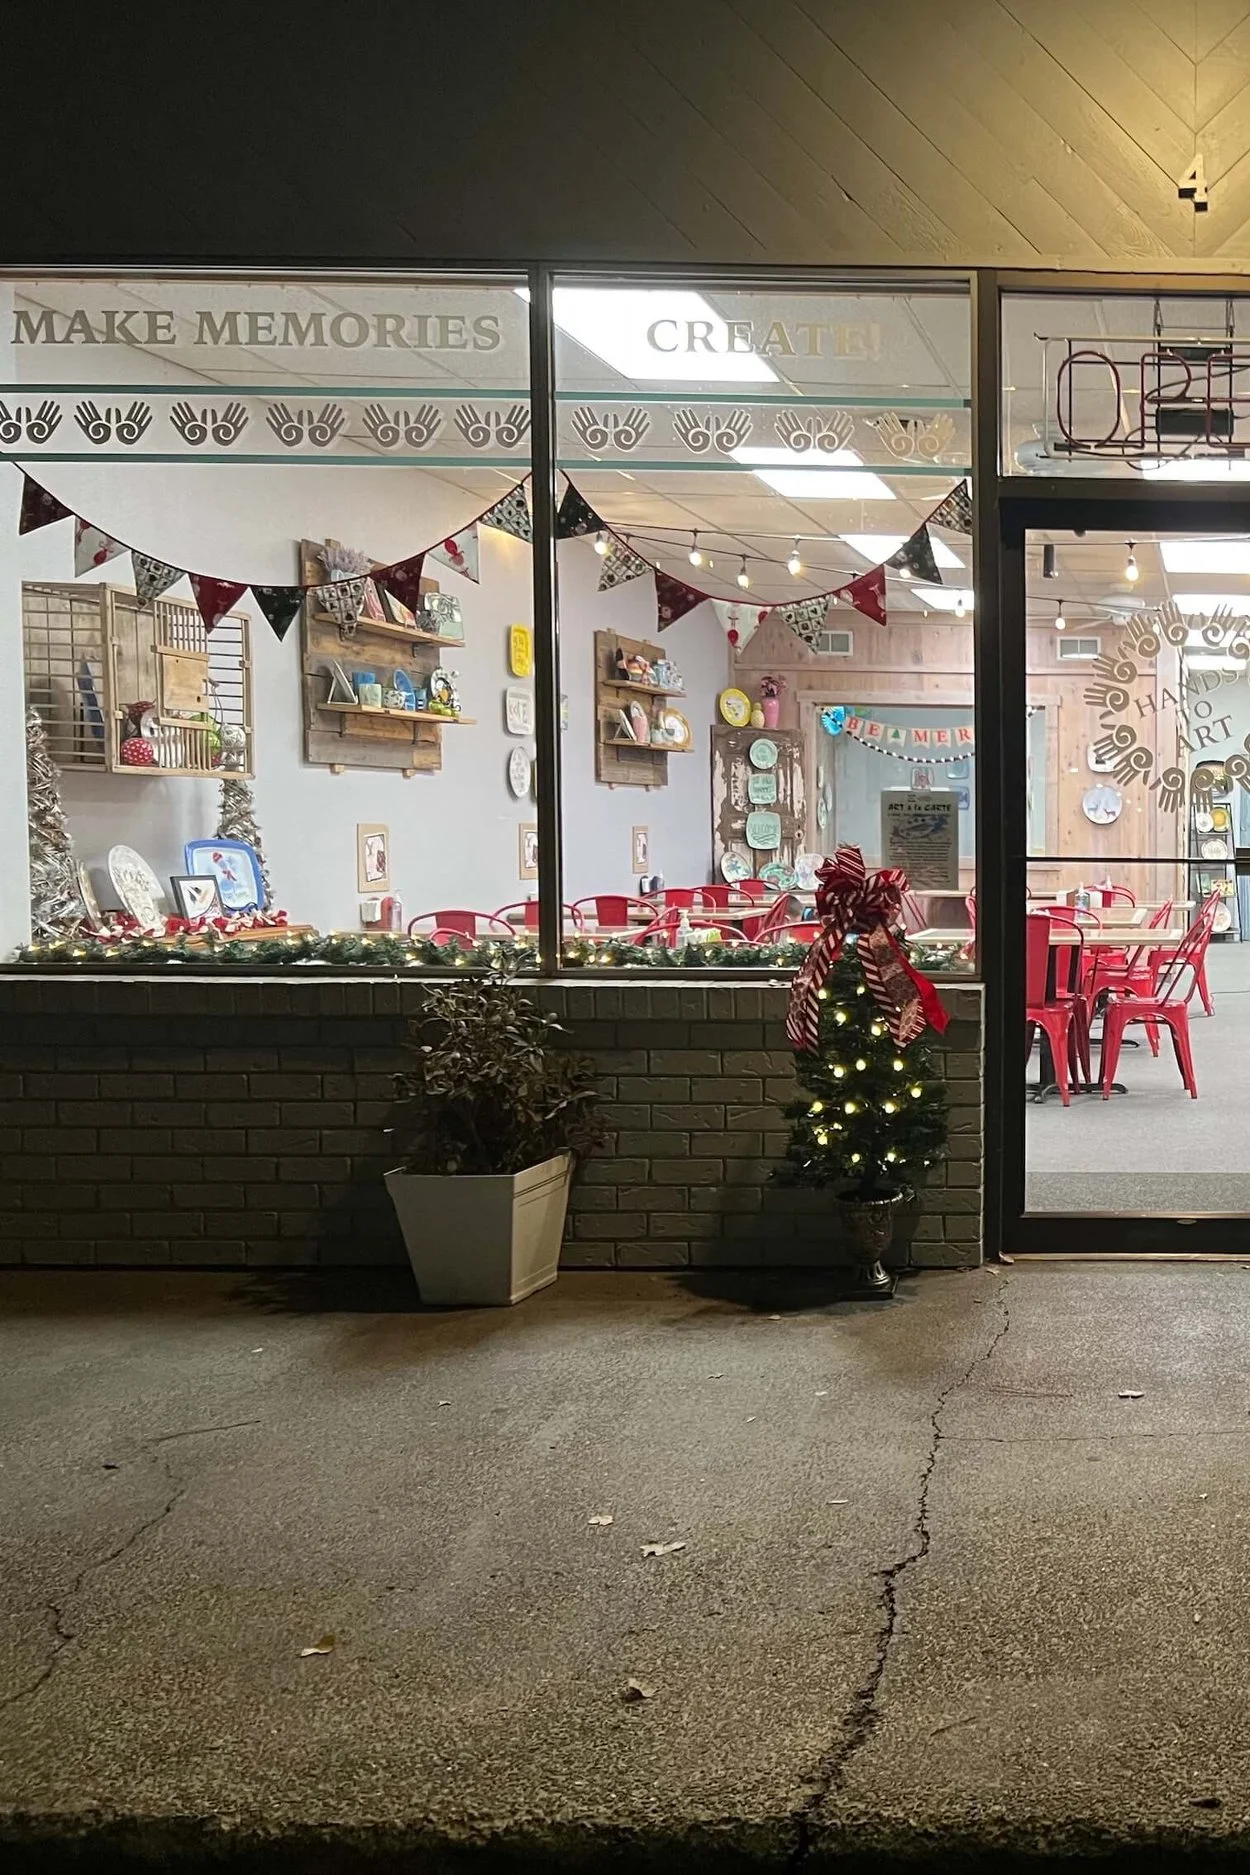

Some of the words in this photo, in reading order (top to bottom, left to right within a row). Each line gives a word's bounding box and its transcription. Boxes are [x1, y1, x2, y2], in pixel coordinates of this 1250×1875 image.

[1178, 153, 1208, 212] 4
[11, 310, 177, 345] MAKE
[194, 311, 501, 351] MEMORIES
[647, 319, 882, 358] CREATE!
[1134, 667, 1239, 718] HANDS
[847, 716, 879, 737] BE
[1176, 700, 1212, 730] TO
[1178, 715, 1233, 758] ART
[888, 803, 904, 811] ART
[924, 803, 951, 812] CARTE
